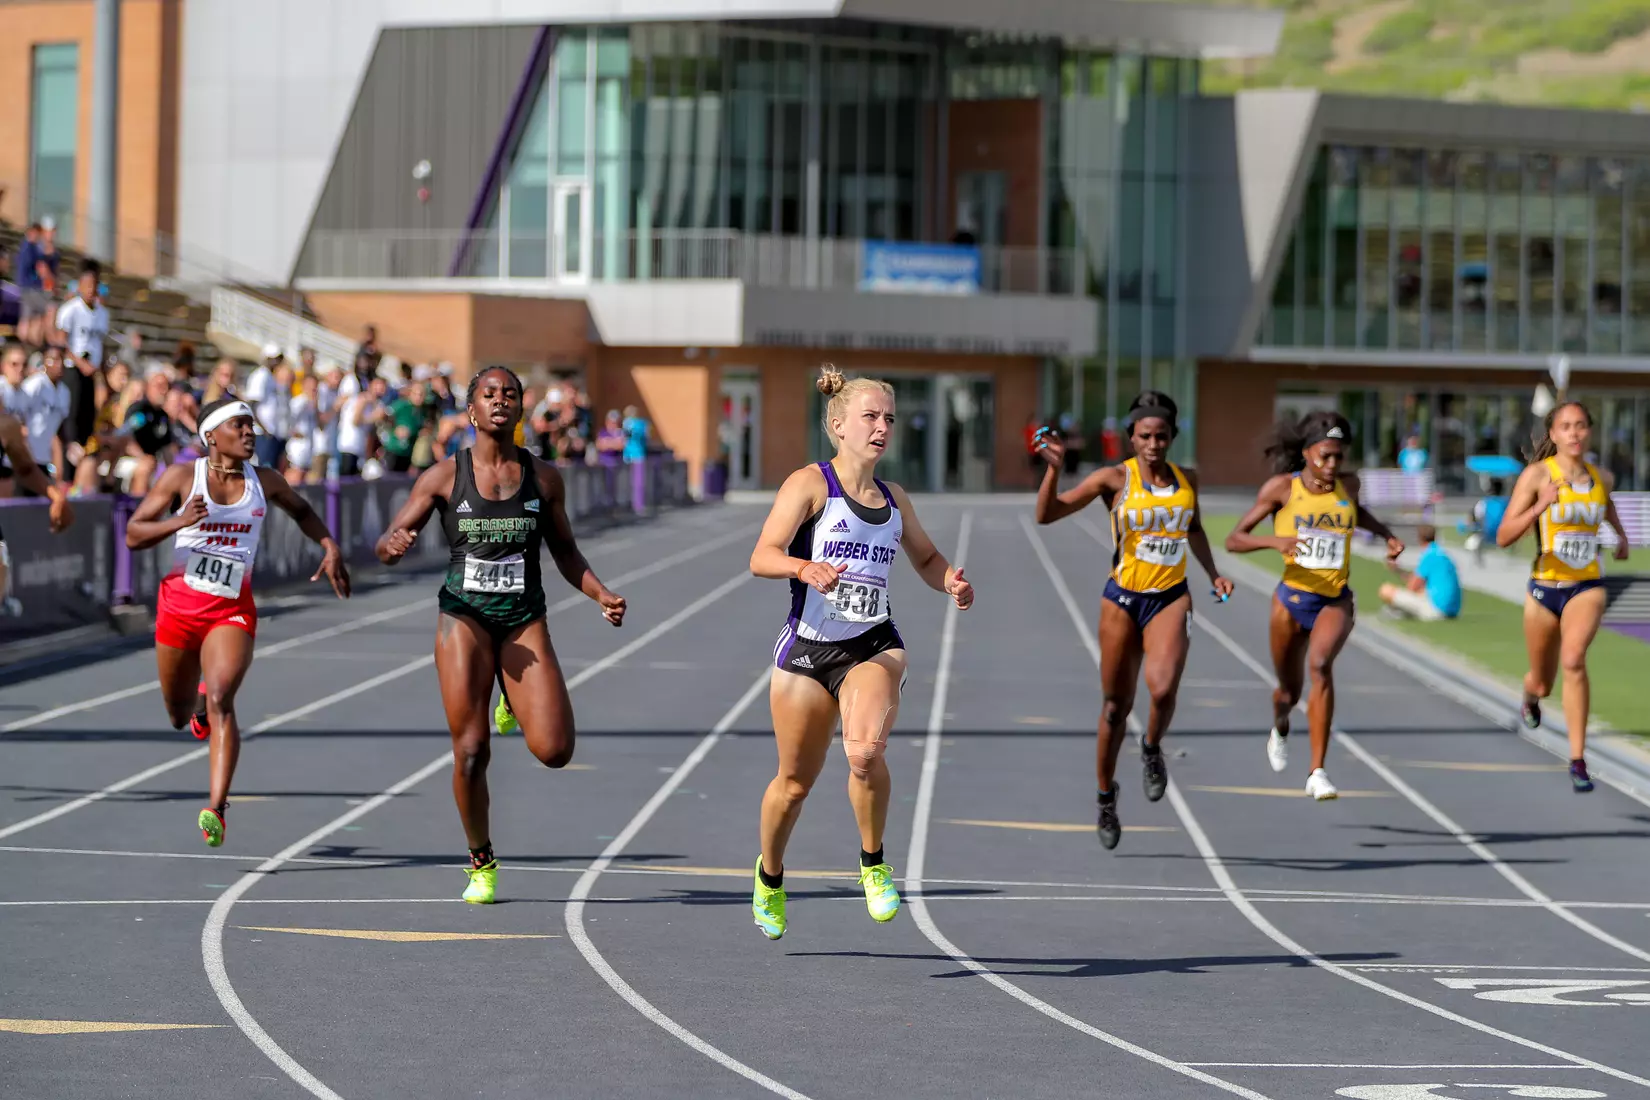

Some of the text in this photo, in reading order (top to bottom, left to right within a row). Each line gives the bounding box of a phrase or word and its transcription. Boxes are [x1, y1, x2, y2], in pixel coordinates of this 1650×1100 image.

[458, 517, 537, 532] SACRAMENTO
[467, 532, 529, 544] STATE
[823, 541, 869, 561] WEBER
[1560, 540, 1590, 560] 402
[195, 557, 233, 587] 491
[474, 562, 516, 588] 445
[836, 583, 880, 617] 538
[791, 659, 814, 669] adidas
